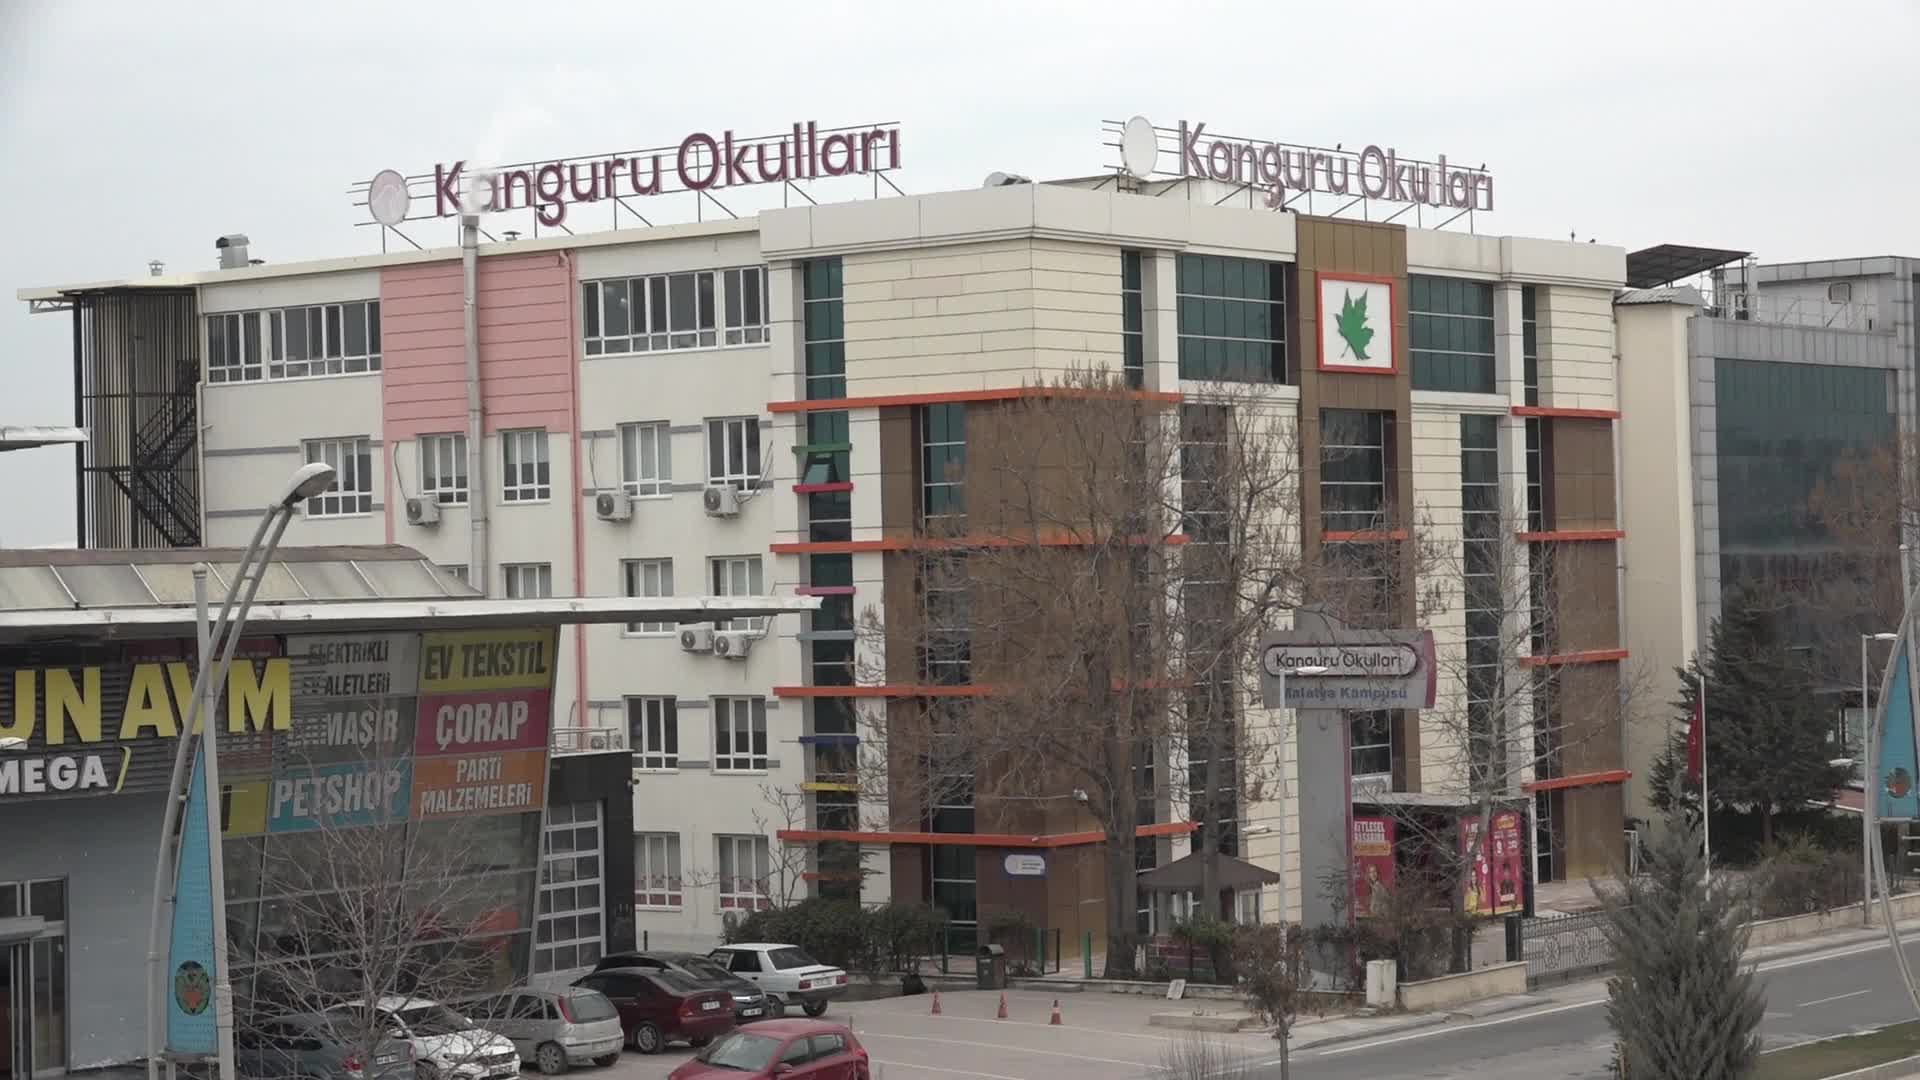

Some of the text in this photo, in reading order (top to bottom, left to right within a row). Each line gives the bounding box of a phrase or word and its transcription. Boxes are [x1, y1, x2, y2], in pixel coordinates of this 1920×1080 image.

[677, 121, 901, 191] Okulları
[1179, 120, 1348, 208] Kanguru
[425, 640, 547, 680] EV TEKSTİL
[436, 701, 528, 750] ÇORAP
[457, 756, 502, 783] PARTİ
[272, 770, 401, 818] PETSHOP
[421, 783, 532, 814] MALZEMELERİ
